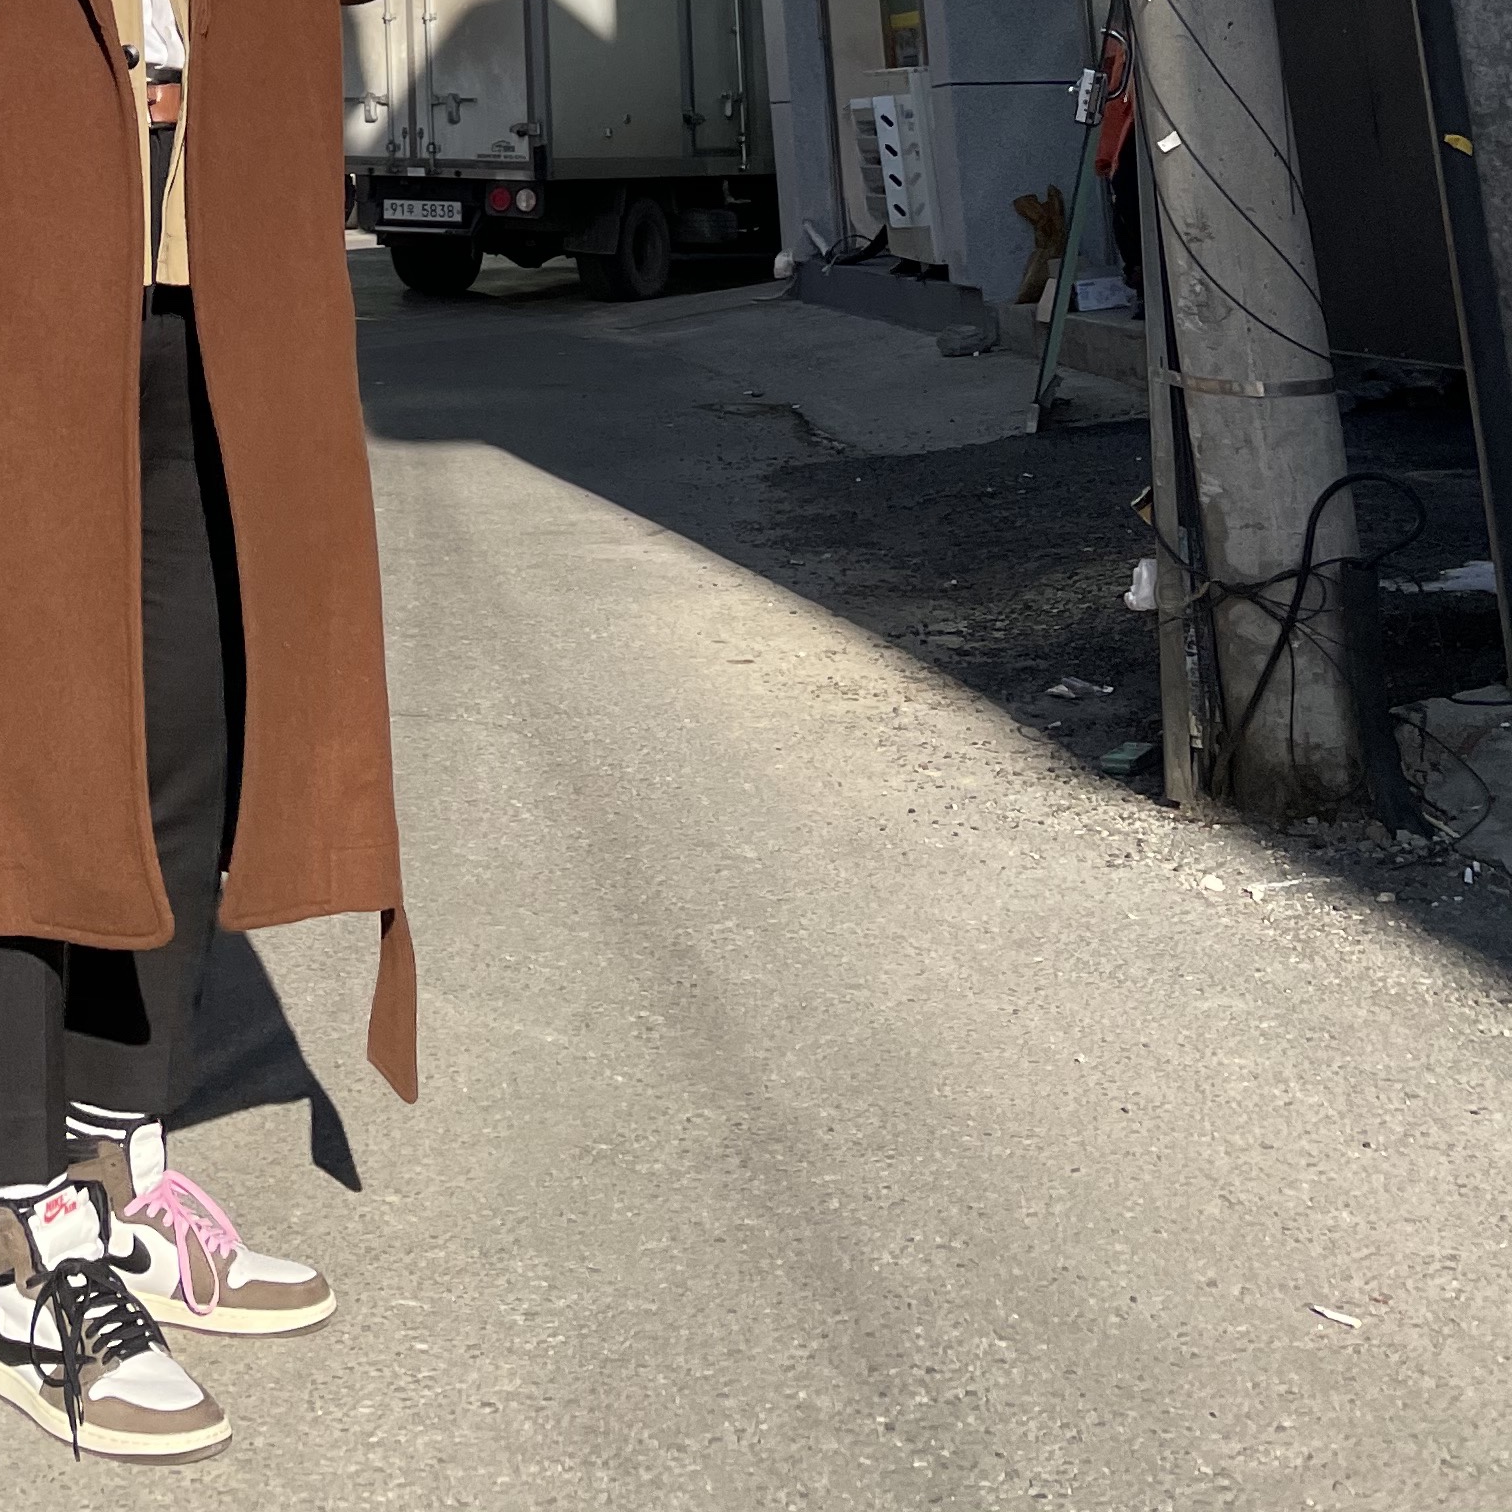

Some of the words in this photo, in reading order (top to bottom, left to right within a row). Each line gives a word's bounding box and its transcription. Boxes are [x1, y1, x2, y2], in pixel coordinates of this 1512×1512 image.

[421, 203, 455, 218] 5838
[46, 1195, 64, 1211] NIKE
[64, 1201, 77, 1215] AIR
